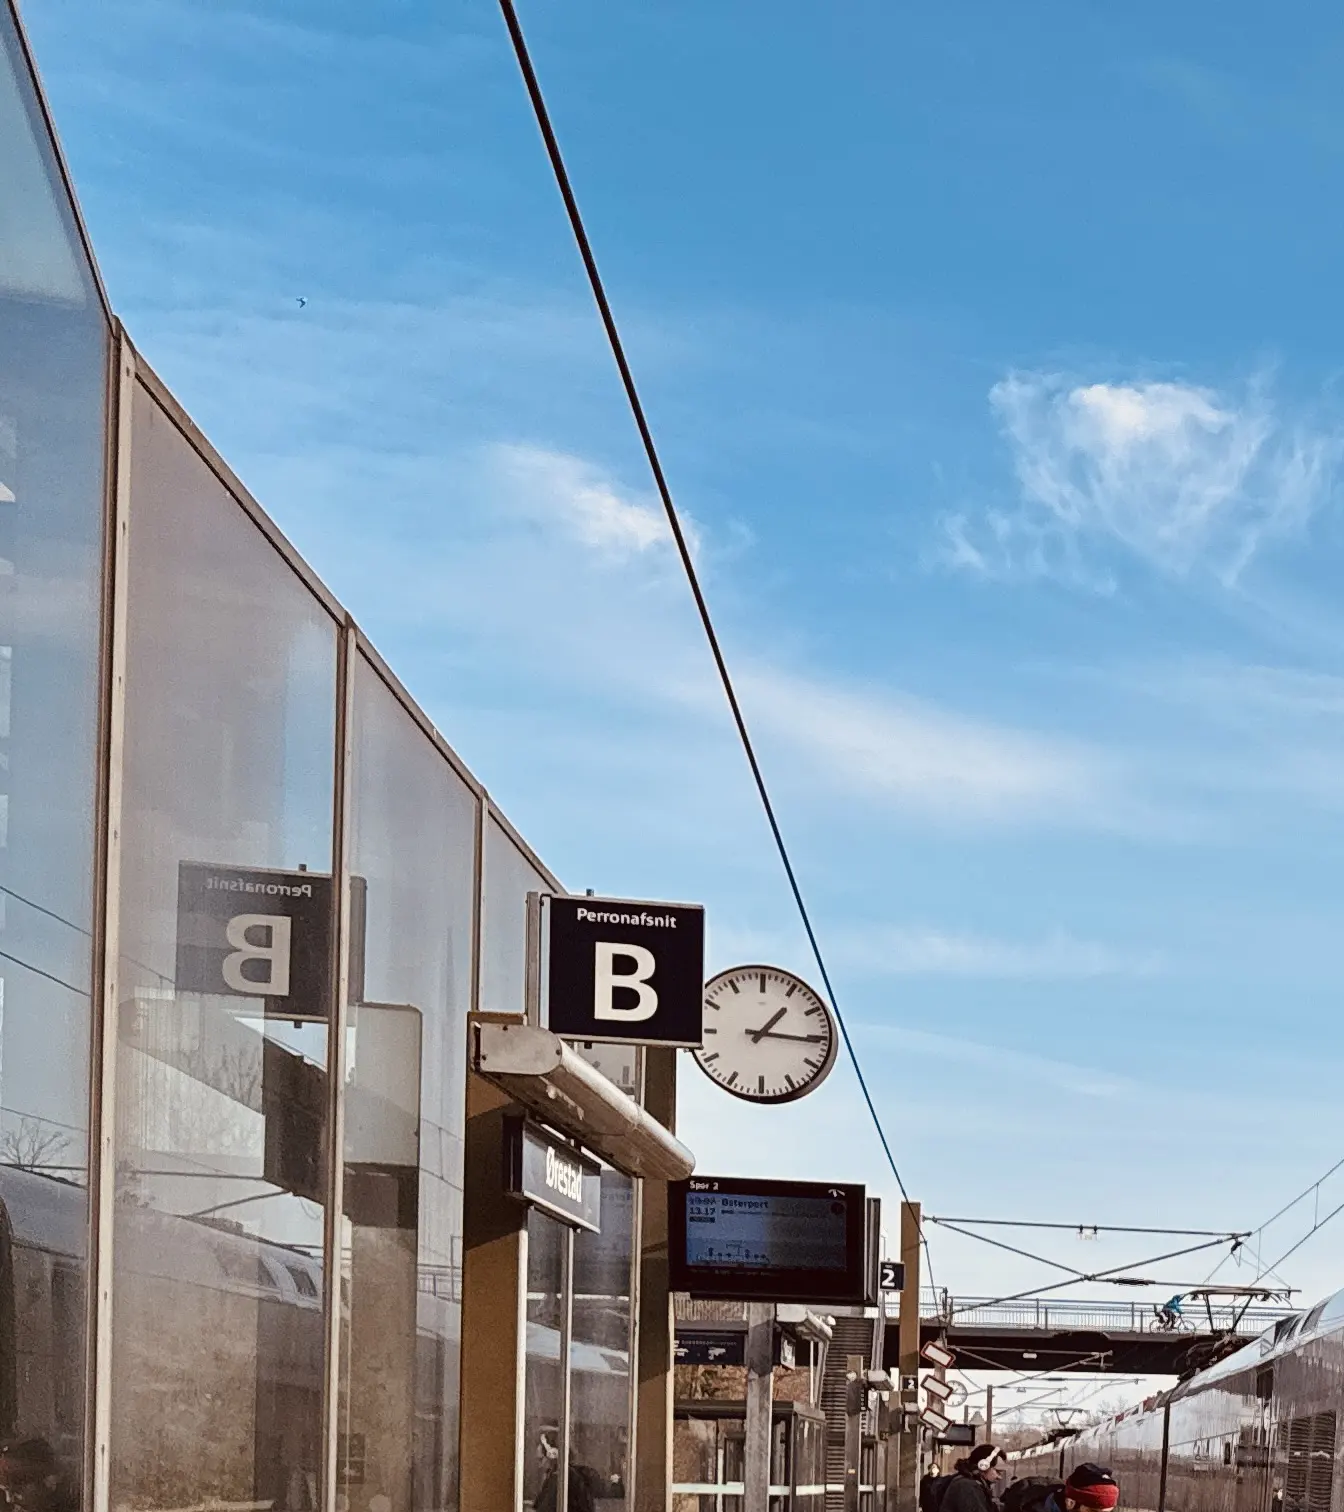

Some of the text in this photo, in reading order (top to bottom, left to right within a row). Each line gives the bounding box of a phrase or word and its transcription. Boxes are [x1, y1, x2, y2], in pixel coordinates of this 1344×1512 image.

[576, 907, 677, 929] Perronafsnit
[594, 941, 659, 1022] B
[545, 1145, 583, 1203] Ørestad
[689, 1180, 719, 1190] Spor 2
[881, 1268, 895, 1288] 2
[907, 1379, 915, 1390] 2
